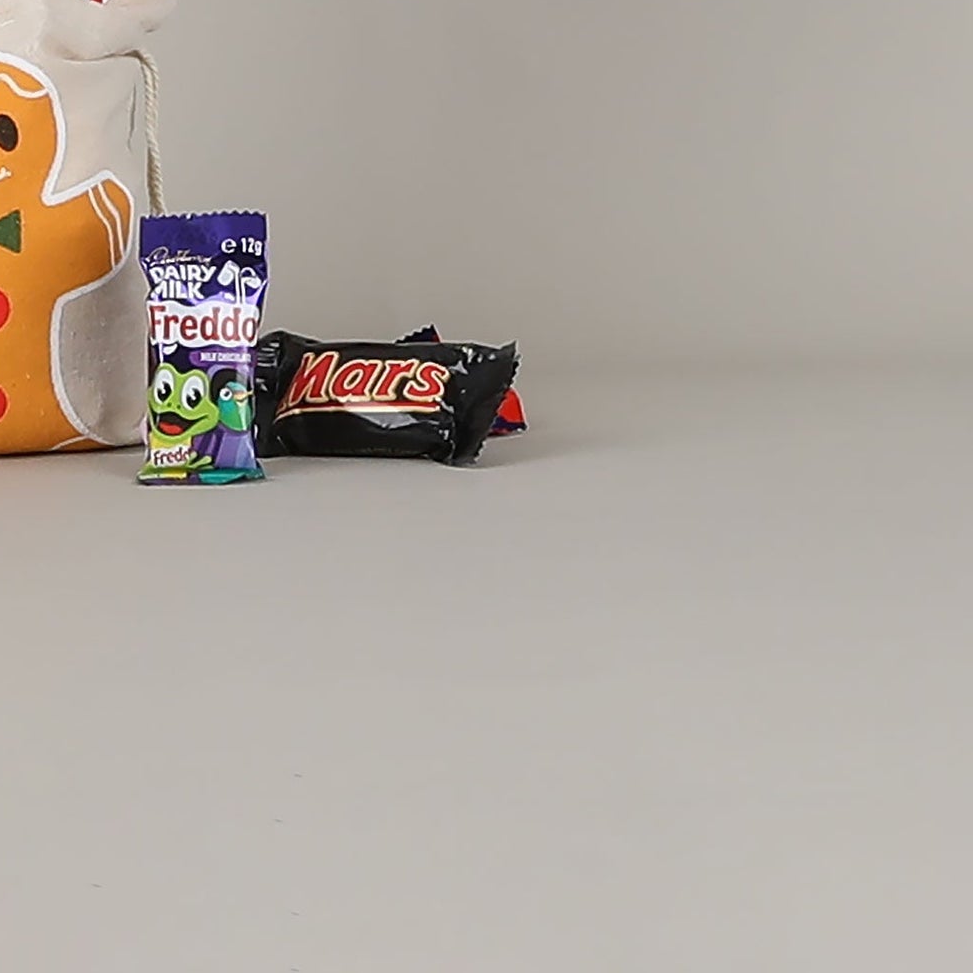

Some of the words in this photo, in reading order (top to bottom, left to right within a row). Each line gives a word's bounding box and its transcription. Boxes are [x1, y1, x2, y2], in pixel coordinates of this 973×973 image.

[240, 237, 263, 257] 12g
[148, 263, 217, 286] DAIRY
[149, 278, 205, 300] MILK
[148, 304, 258, 343] Freddo
[279, 350, 450, 412] Mars
